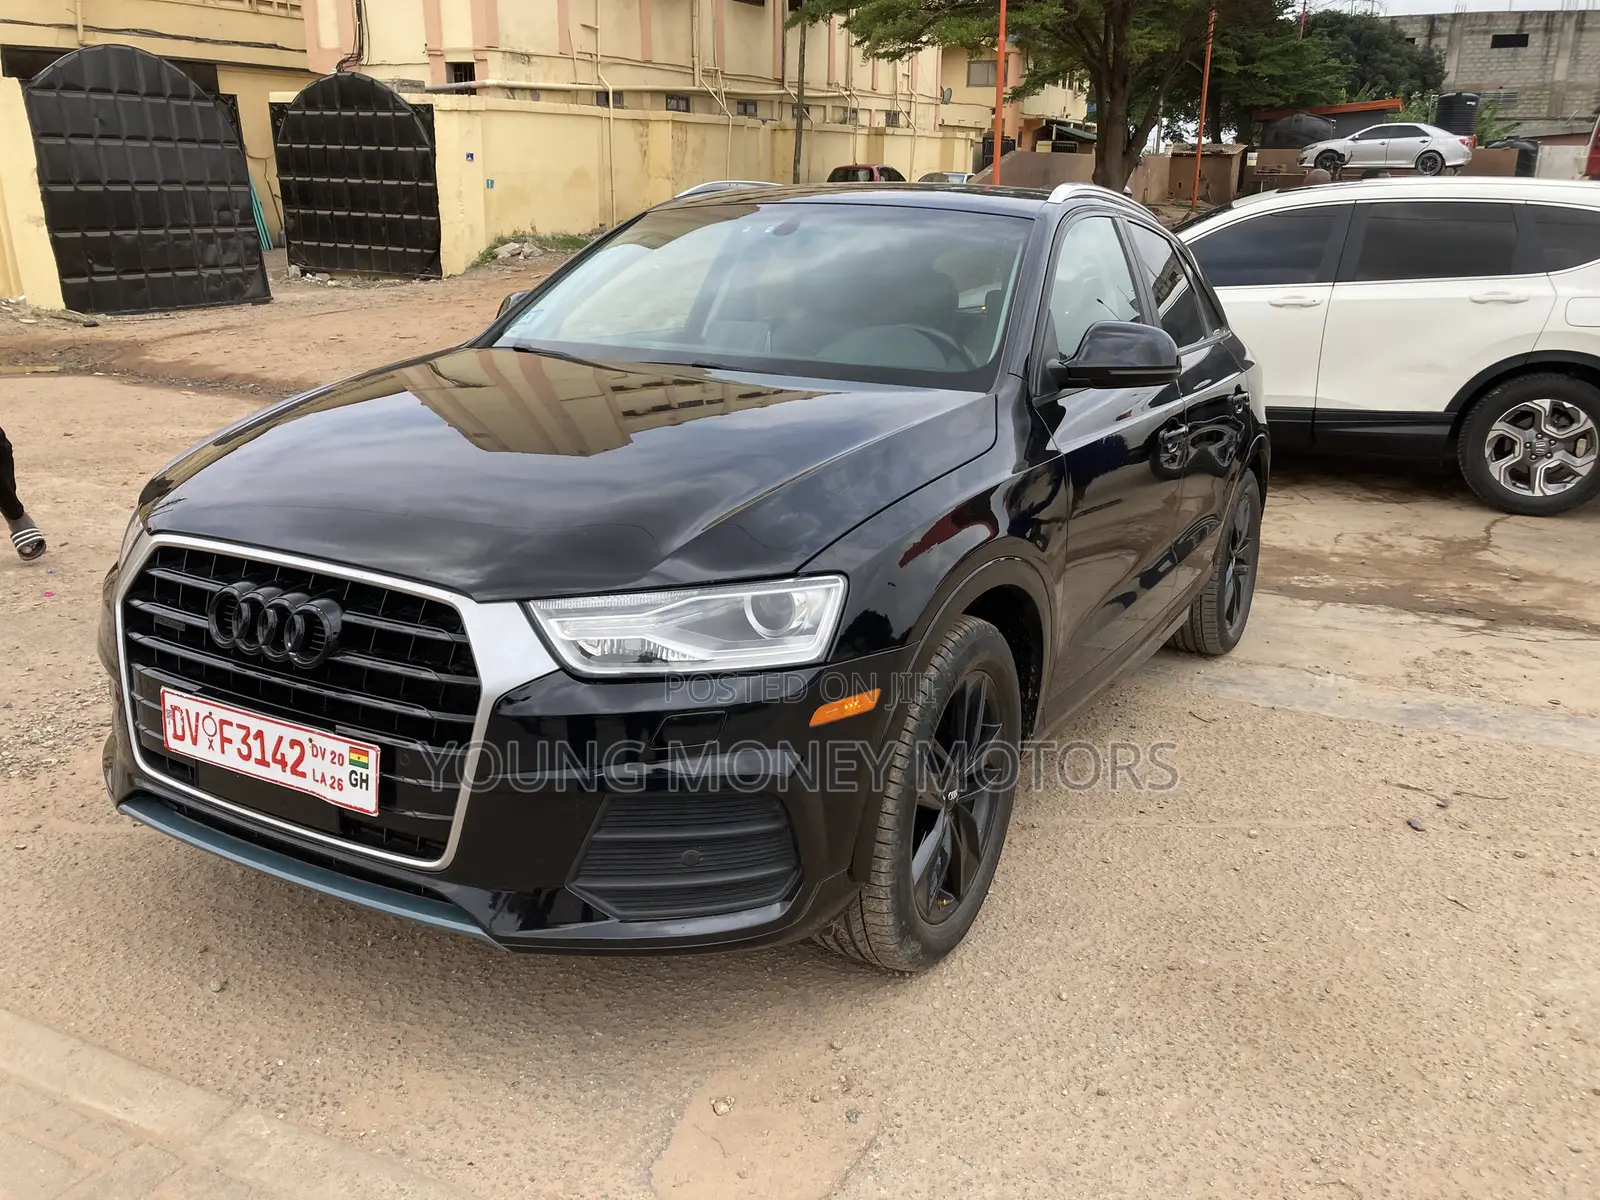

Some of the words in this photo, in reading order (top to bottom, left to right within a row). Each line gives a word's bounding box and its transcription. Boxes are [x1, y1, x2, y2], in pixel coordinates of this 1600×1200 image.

[170, 704, 200, 746] DV
[218, 718, 307, 779] F3142
[311, 743, 327, 761] DV
[330, 750, 345, 767] 20
[312, 768, 328, 787] LA
[329, 777, 344, 792] 26
[349, 770, 369, 791] GH
